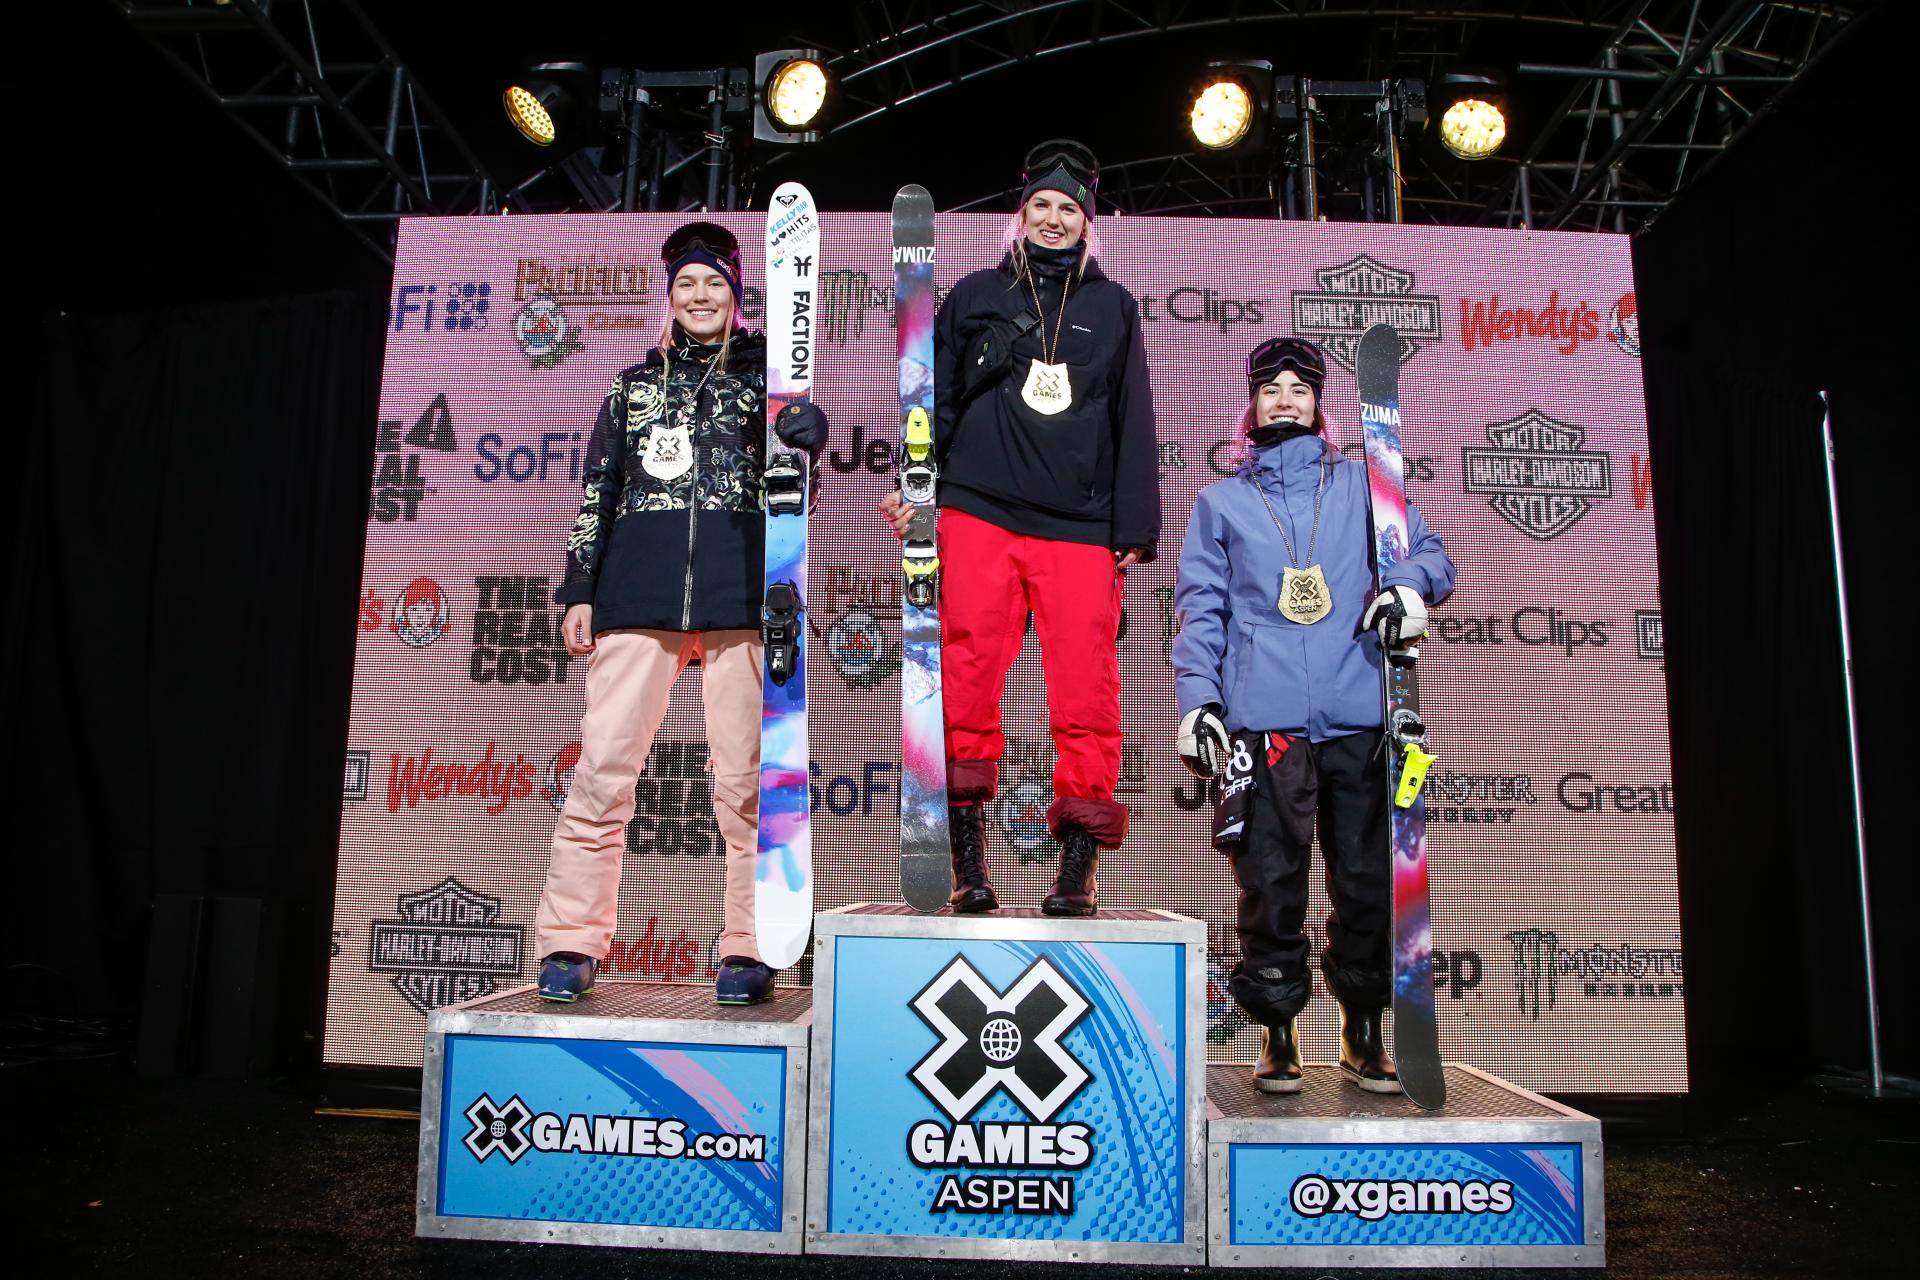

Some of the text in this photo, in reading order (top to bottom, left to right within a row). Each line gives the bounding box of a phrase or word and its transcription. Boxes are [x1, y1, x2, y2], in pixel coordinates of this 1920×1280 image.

[770, 208, 797, 234] KELLY
[787, 213, 810, 235] HITS
[893, 246, 935, 264] ZUMA
[1331, 263, 1400, 294] MOTOR
[1166, 286, 1264, 334] Clips
[1301, 302, 1432, 330] HARLEY-DAVIDSON
[1459, 289, 1600, 355] Wendy's
[791, 290, 811, 380] FACTION
[1032, 389, 1062, 400] GAMES
[1360, 402, 1400, 427] ZUMA
[829, 425, 900, 475] Je
[1501, 421, 1572, 451] MOTOR
[473, 432, 582, 483] SoFi
[1471, 457, 1601, 488] HARLEY-DAVIDSON
[1505, 495, 1576, 528] CYCLES
[474, 576, 551, 610] THE
[1289, 598, 1322, 608] GAMES
[1511, 607, 1609, 657] Clips
[470, 648, 573, 684] COST
[386, 740, 537, 816] Wendy's
[1557, 771, 1673, 813] Great
[413, 894, 485, 924] MOTOR
[380, 933, 515, 965] HARLEY-DAVIDSON
[909, 1121, 1092, 1167] GAMES
[935, 1176, 1072, 1213] ASPEN
[1291, 1175, 1514, 1218] @xgames
